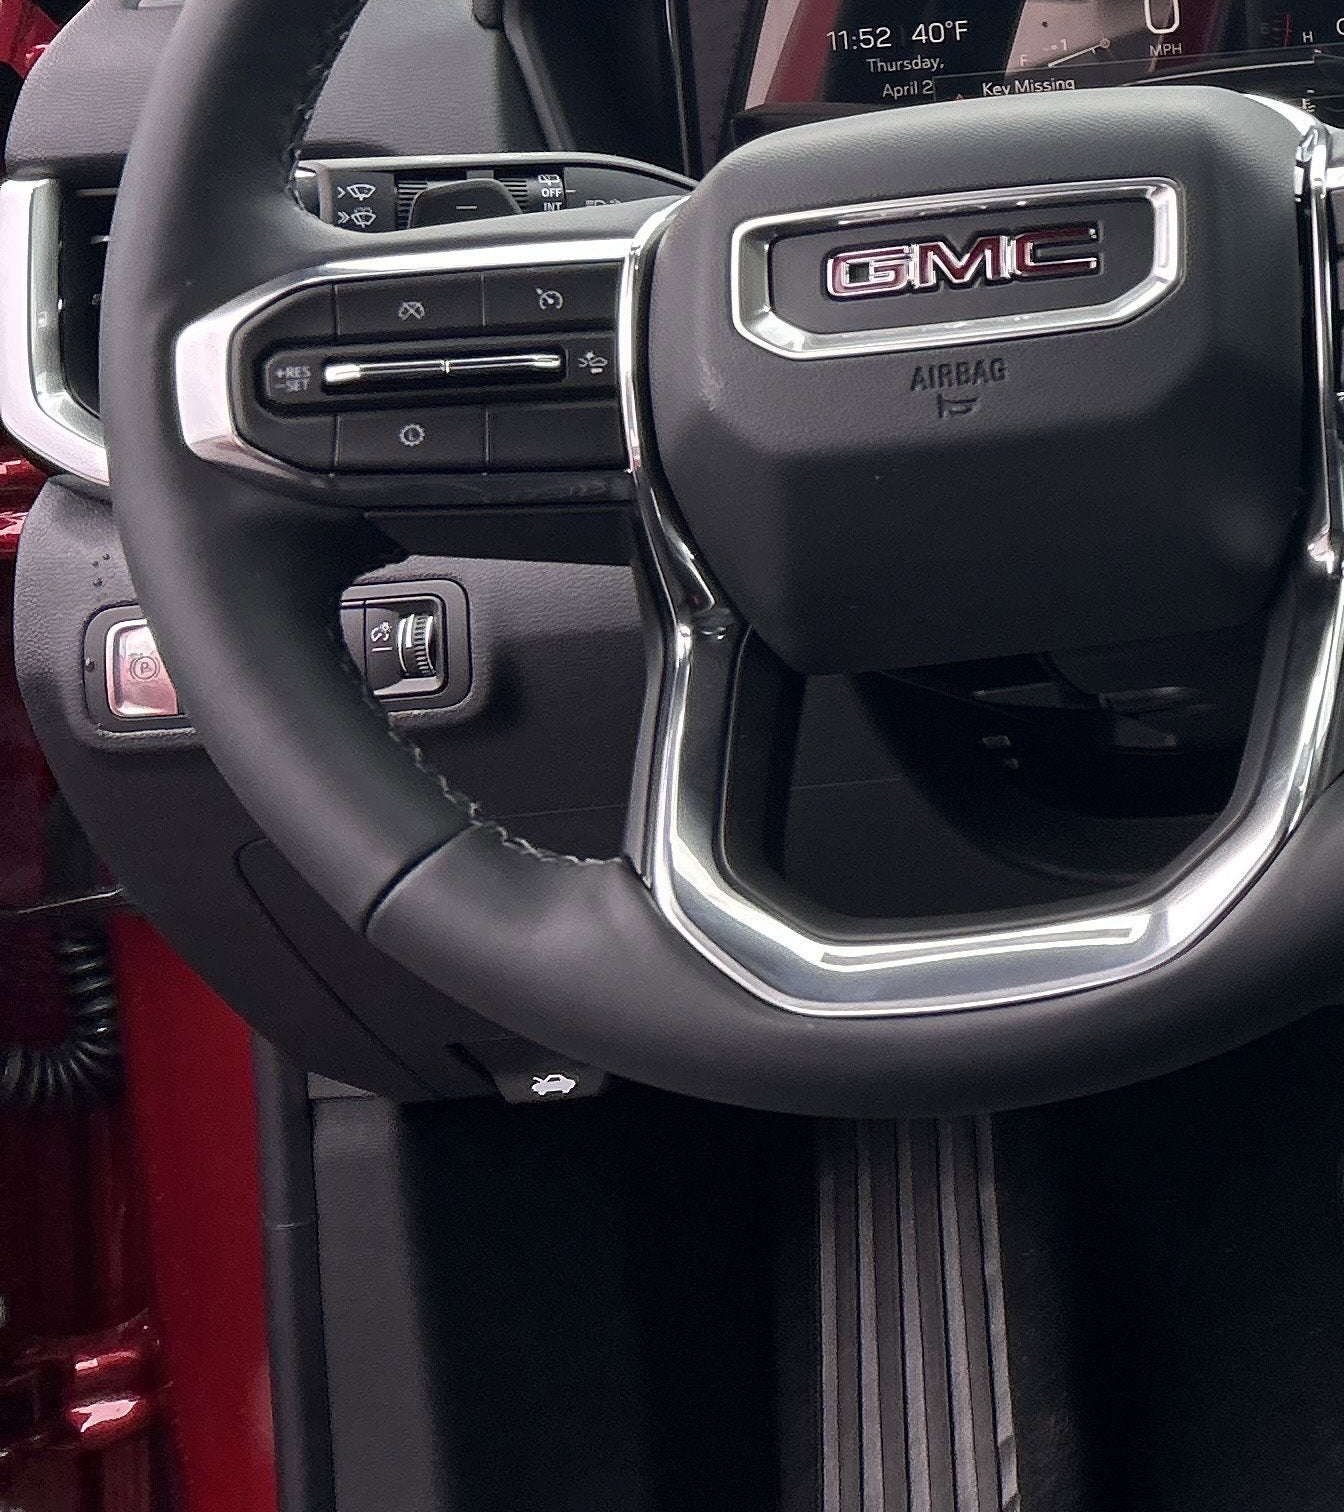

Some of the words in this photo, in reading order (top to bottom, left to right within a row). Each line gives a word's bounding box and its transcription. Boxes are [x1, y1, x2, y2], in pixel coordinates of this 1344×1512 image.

[826, 26, 893, 52] 11:52
[911, 20, 968, 44] 40°F
[1150, 41, 1183, 57] MPH
[866, 57, 945, 75] Thursday,
[880, 80, 920, 100] April
[541, 187, 563, 199] OFF
[826, 227, 1098, 297] GMC
[910, 357, 1006, 391] AIRBAG
